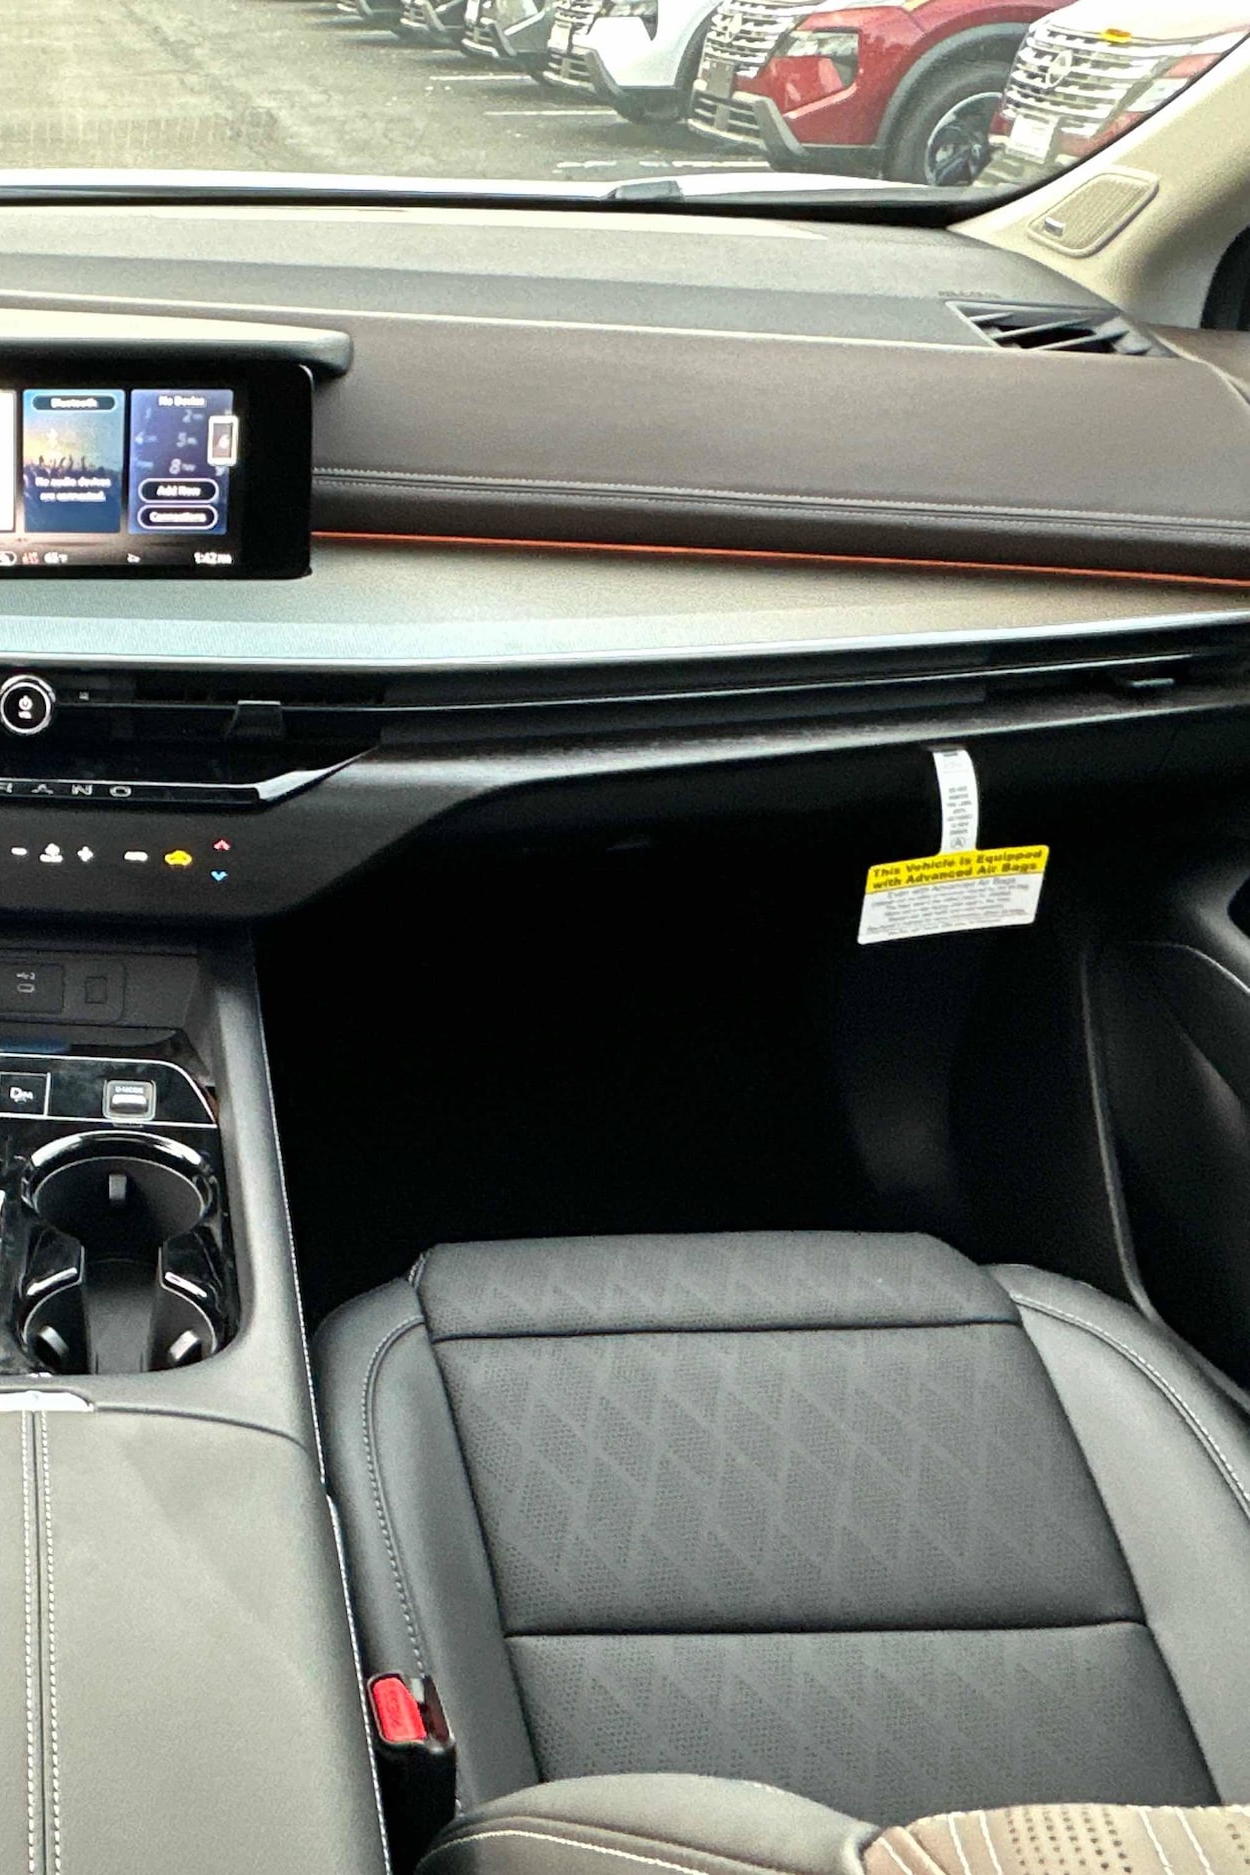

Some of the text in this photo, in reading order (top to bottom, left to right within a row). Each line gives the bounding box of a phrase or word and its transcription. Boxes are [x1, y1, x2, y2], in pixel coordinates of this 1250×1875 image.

[872, 862, 1037, 889] with Advanced Air Bags
[873, 849, 1043, 878] This Vehicle is Equipped
